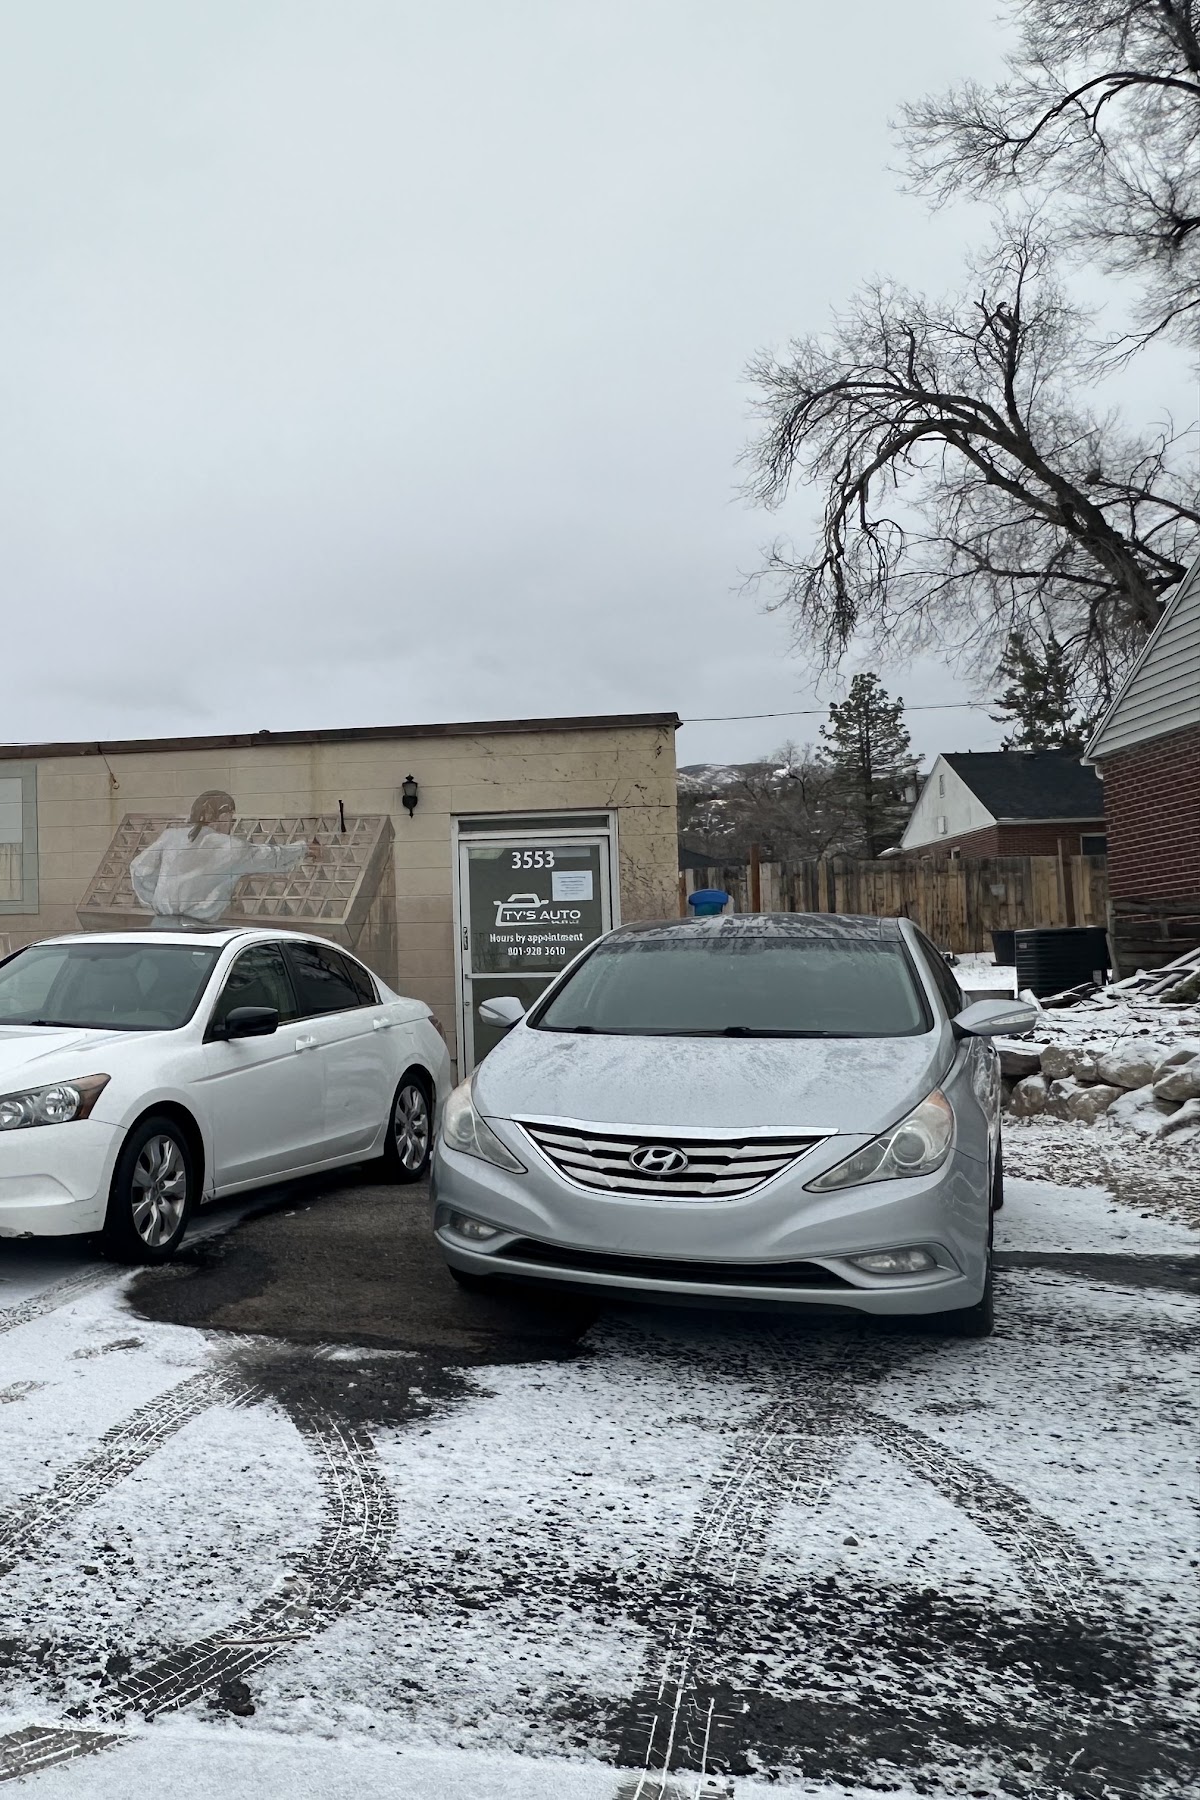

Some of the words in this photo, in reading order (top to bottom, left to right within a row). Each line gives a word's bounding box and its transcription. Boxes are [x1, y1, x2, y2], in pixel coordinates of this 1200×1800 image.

[511, 851, 555, 869] 3553
[503, 911, 536, 920] TY'S
[540, 910, 581, 919] AUTO
[489, 933, 514, 943] Hours
[516, 933, 526, 944] by
[527, 933, 584, 944] appointment
[544, 946, 566, 956] 3610
